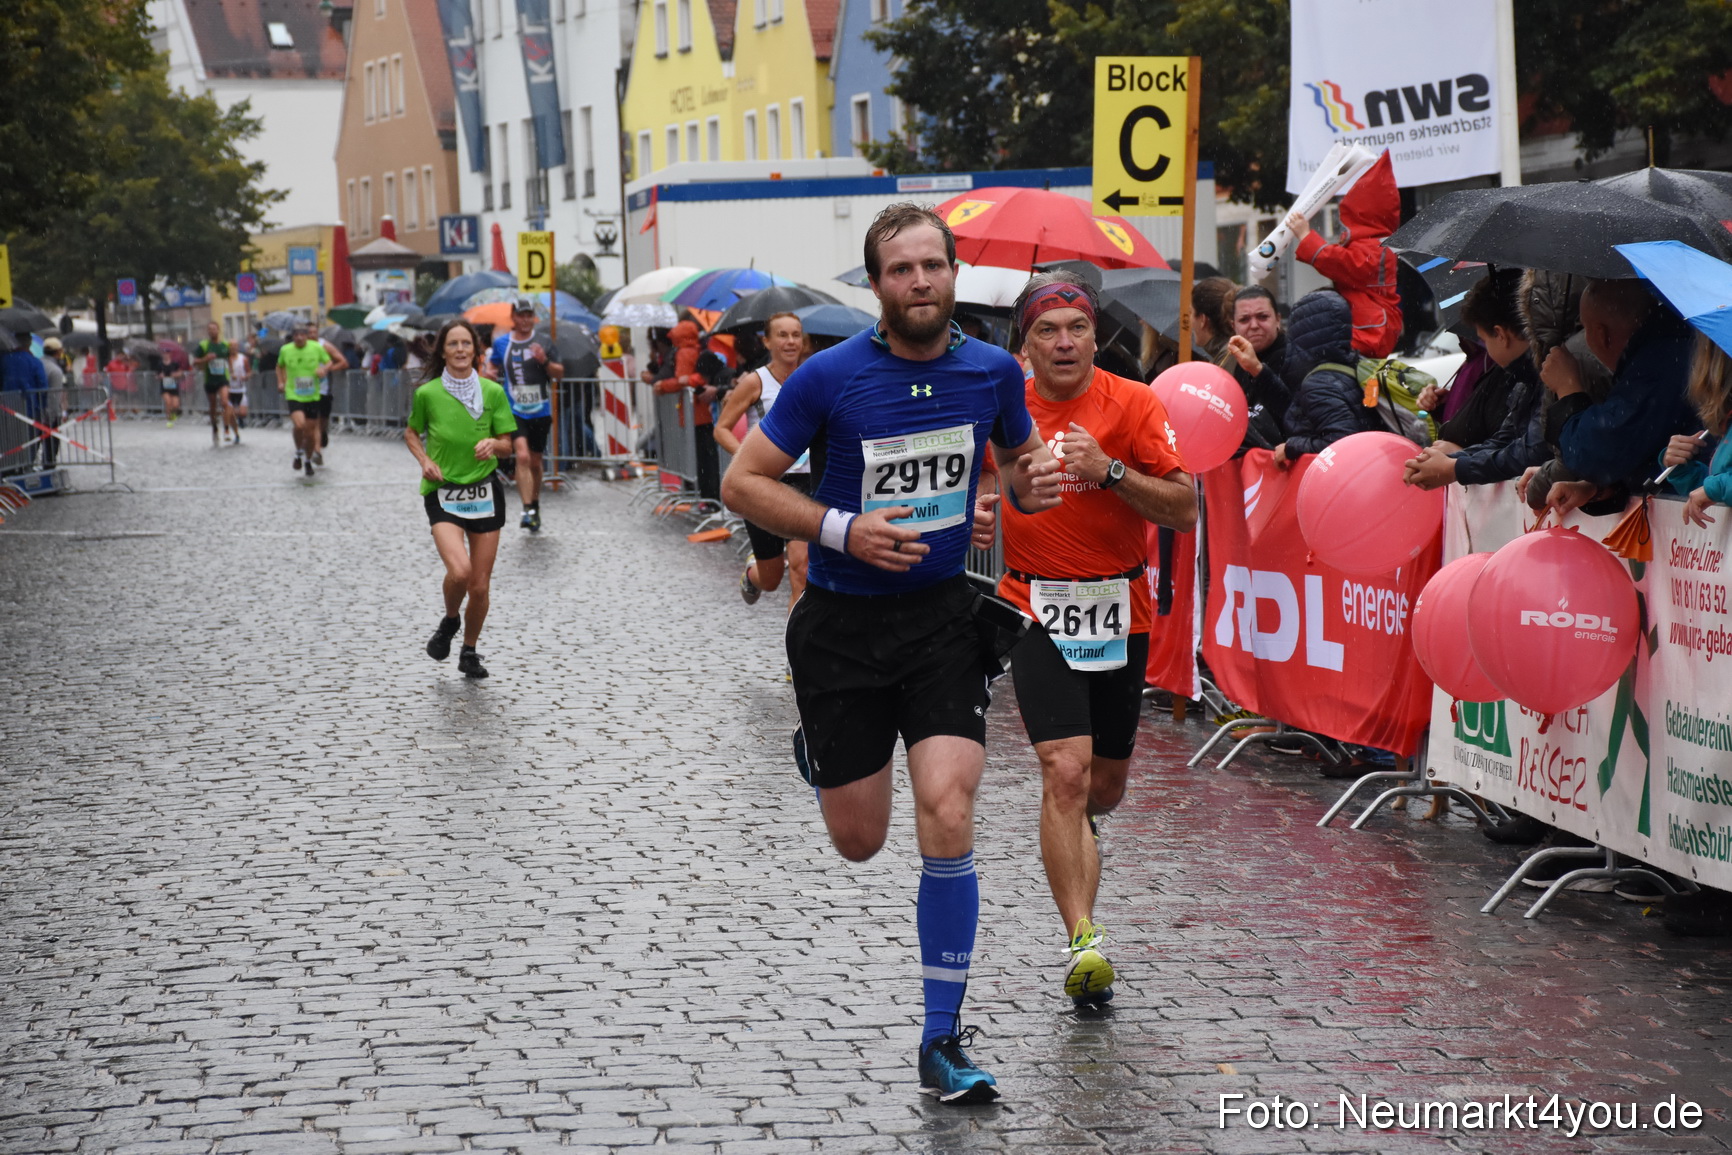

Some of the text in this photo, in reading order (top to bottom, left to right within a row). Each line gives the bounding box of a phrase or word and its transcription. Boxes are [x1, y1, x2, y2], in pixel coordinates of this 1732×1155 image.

[1108, 64, 1187, 92] Block
[1119, 105, 1171, 182] C
[521, 234, 552, 246] Block
[528, 250, 546, 280] D
[873, 447, 908, 458] NeuerMarkt
[913, 430, 966, 450] BOCK
[874, 453, 966, 495] 2919
[445, 485, 488, 501] 2296
[456, 503, 478, 512] Gisela
[1669, 537, 1724, 574] Service-Line:
[1076, 584, 1121, 596] BOCK
[1714, 584, 1727, 615] 52
[1042, 602, 1122, 637] 2614
[1215, 564, 1344, 673] RDL
[1060, 644, 1105, 659] Hartmut
